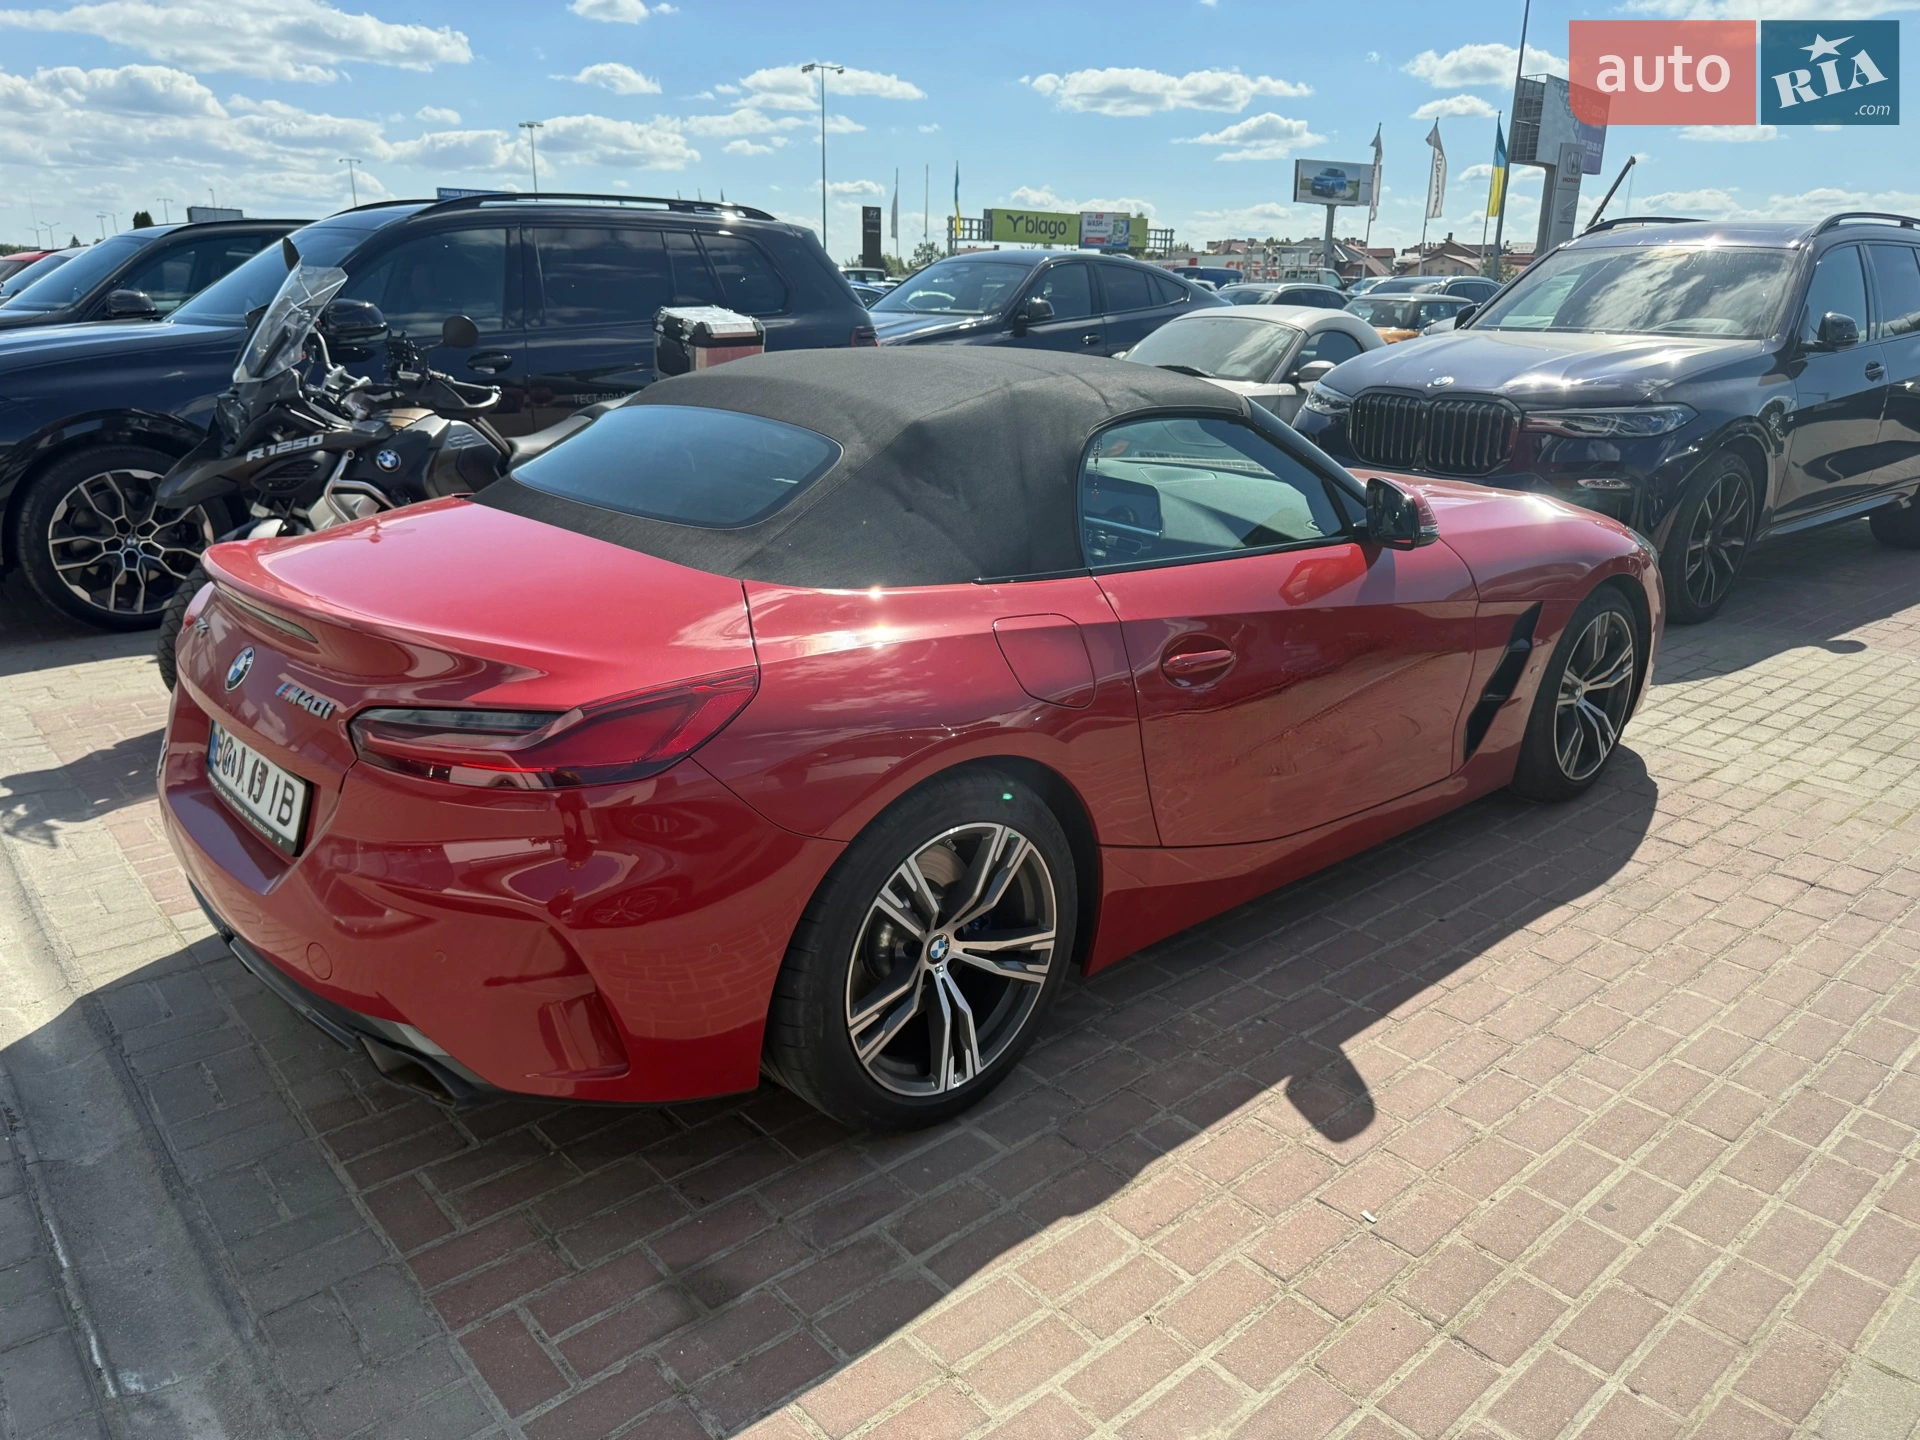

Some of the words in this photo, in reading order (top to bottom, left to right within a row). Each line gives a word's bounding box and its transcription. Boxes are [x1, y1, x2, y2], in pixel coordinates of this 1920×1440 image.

[573, 391, 631, 405] ТЕСТ-ДРАЙ
[246, 448, 265, 462] R
[266, 434, 325, 457] 1250
